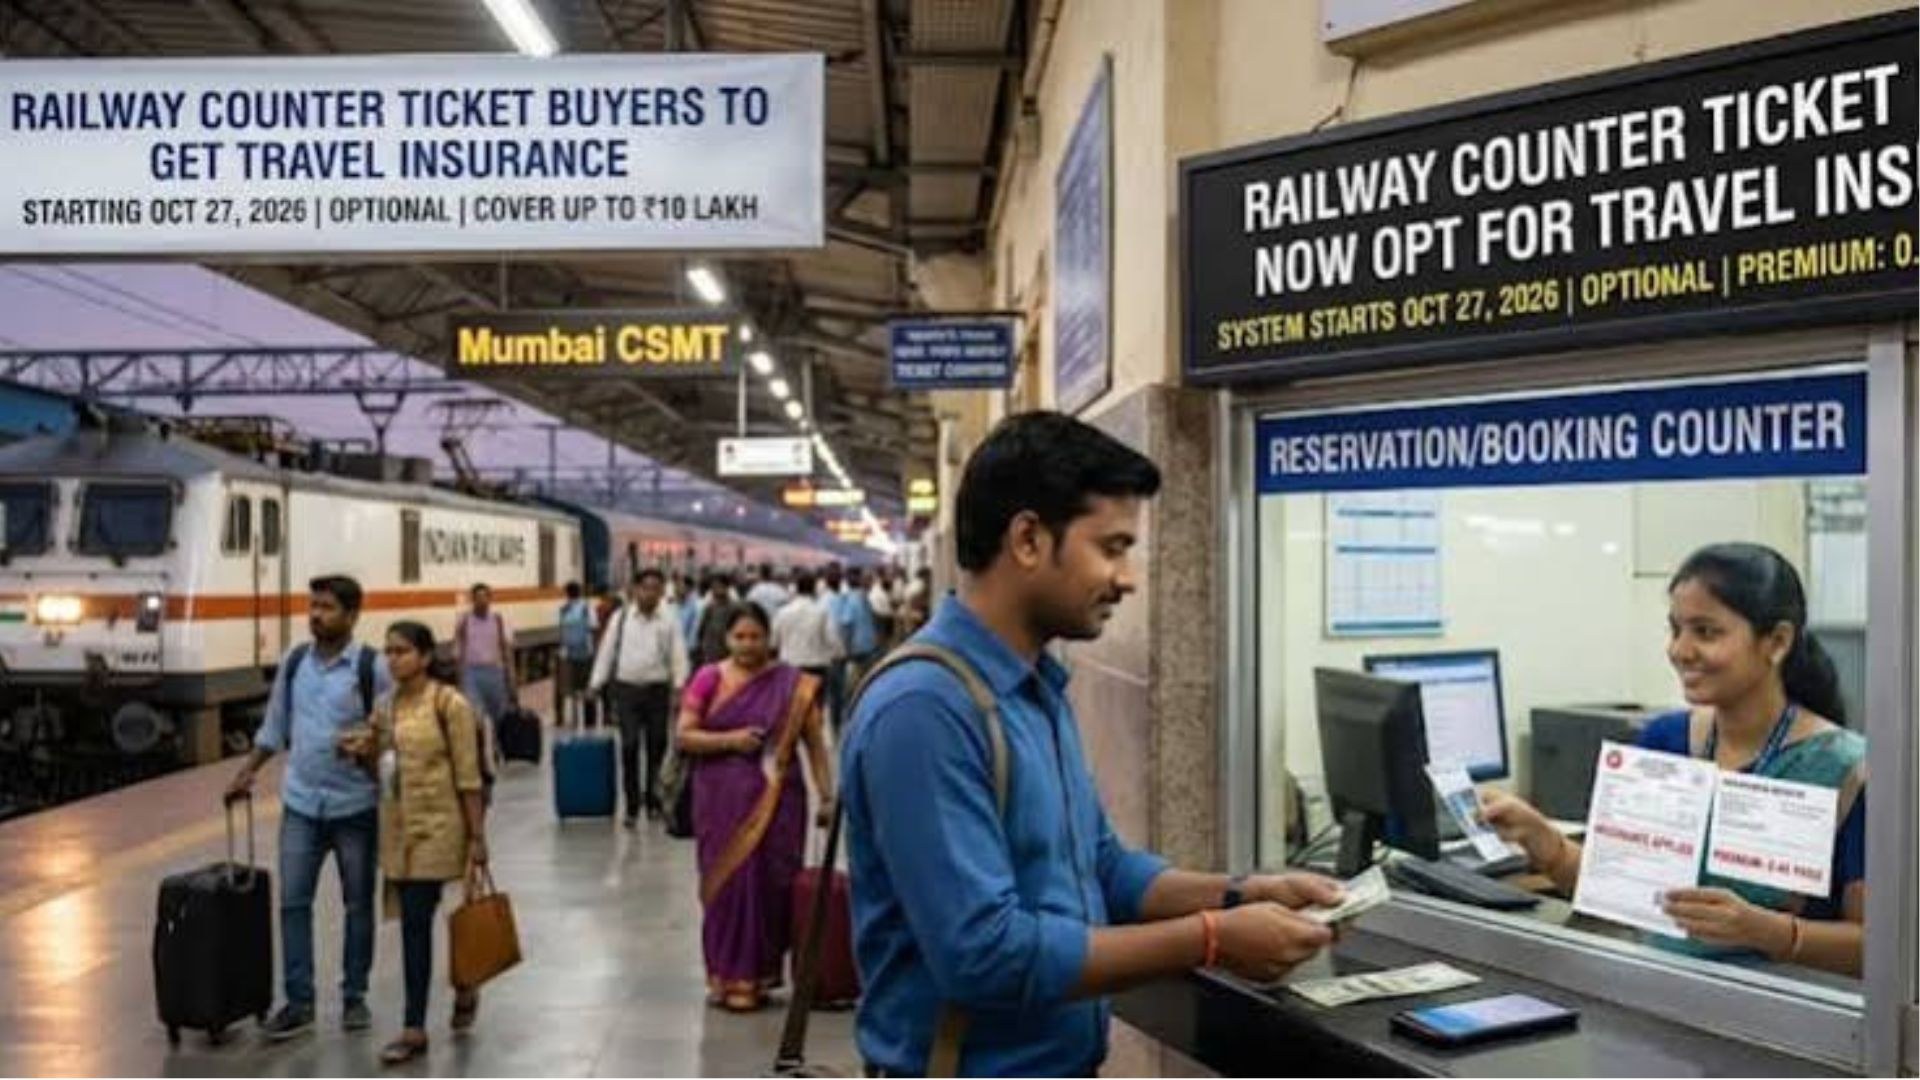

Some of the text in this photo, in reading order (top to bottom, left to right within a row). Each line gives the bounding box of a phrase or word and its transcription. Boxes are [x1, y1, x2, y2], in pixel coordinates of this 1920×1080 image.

[12, 87, 769, 131] RAILWAY COUNTER TICKET BUYERS TO
[150, 140, 629, 181] GET TRAVEL INSURANCE
[1244, 62, 1900, 232] RAILWAY COUNTER TICKET
[23, 200, 141, 225] STARTING
[150, 200, 196, 224] OCT
[205, 200, 240, 228] 27,
[250, 200, 307, 224] 2026
[329, 198, 450, 223] OPTIONAL
[473, 197, 555, 222] COVER
[564, 196, 597, 221] UP
[605, 196, 635, 221] TO
[694, 196, 758, 220] LAKH
[1255, 142, 1919, 297] NOW OPT FOR TRAVEL INS
[1217, 313, 1305, 350] SYSTEM
[1308, 300, 1397, 338] STARTS
[1402, 294, 1450, 327] OCT
[1455, 289, 1494, 322] 27,
[1499, 280, 1560, 315] 2026
[1581, 261, 1715, 306] OPTIONAL
[1737, 237, 1887, 286] PREMIUM:
[458, 324, 730, 365] Mumbai CSMT
[1269, 401, 1846, 476] RESERVATION/BOOKING COUNTER
